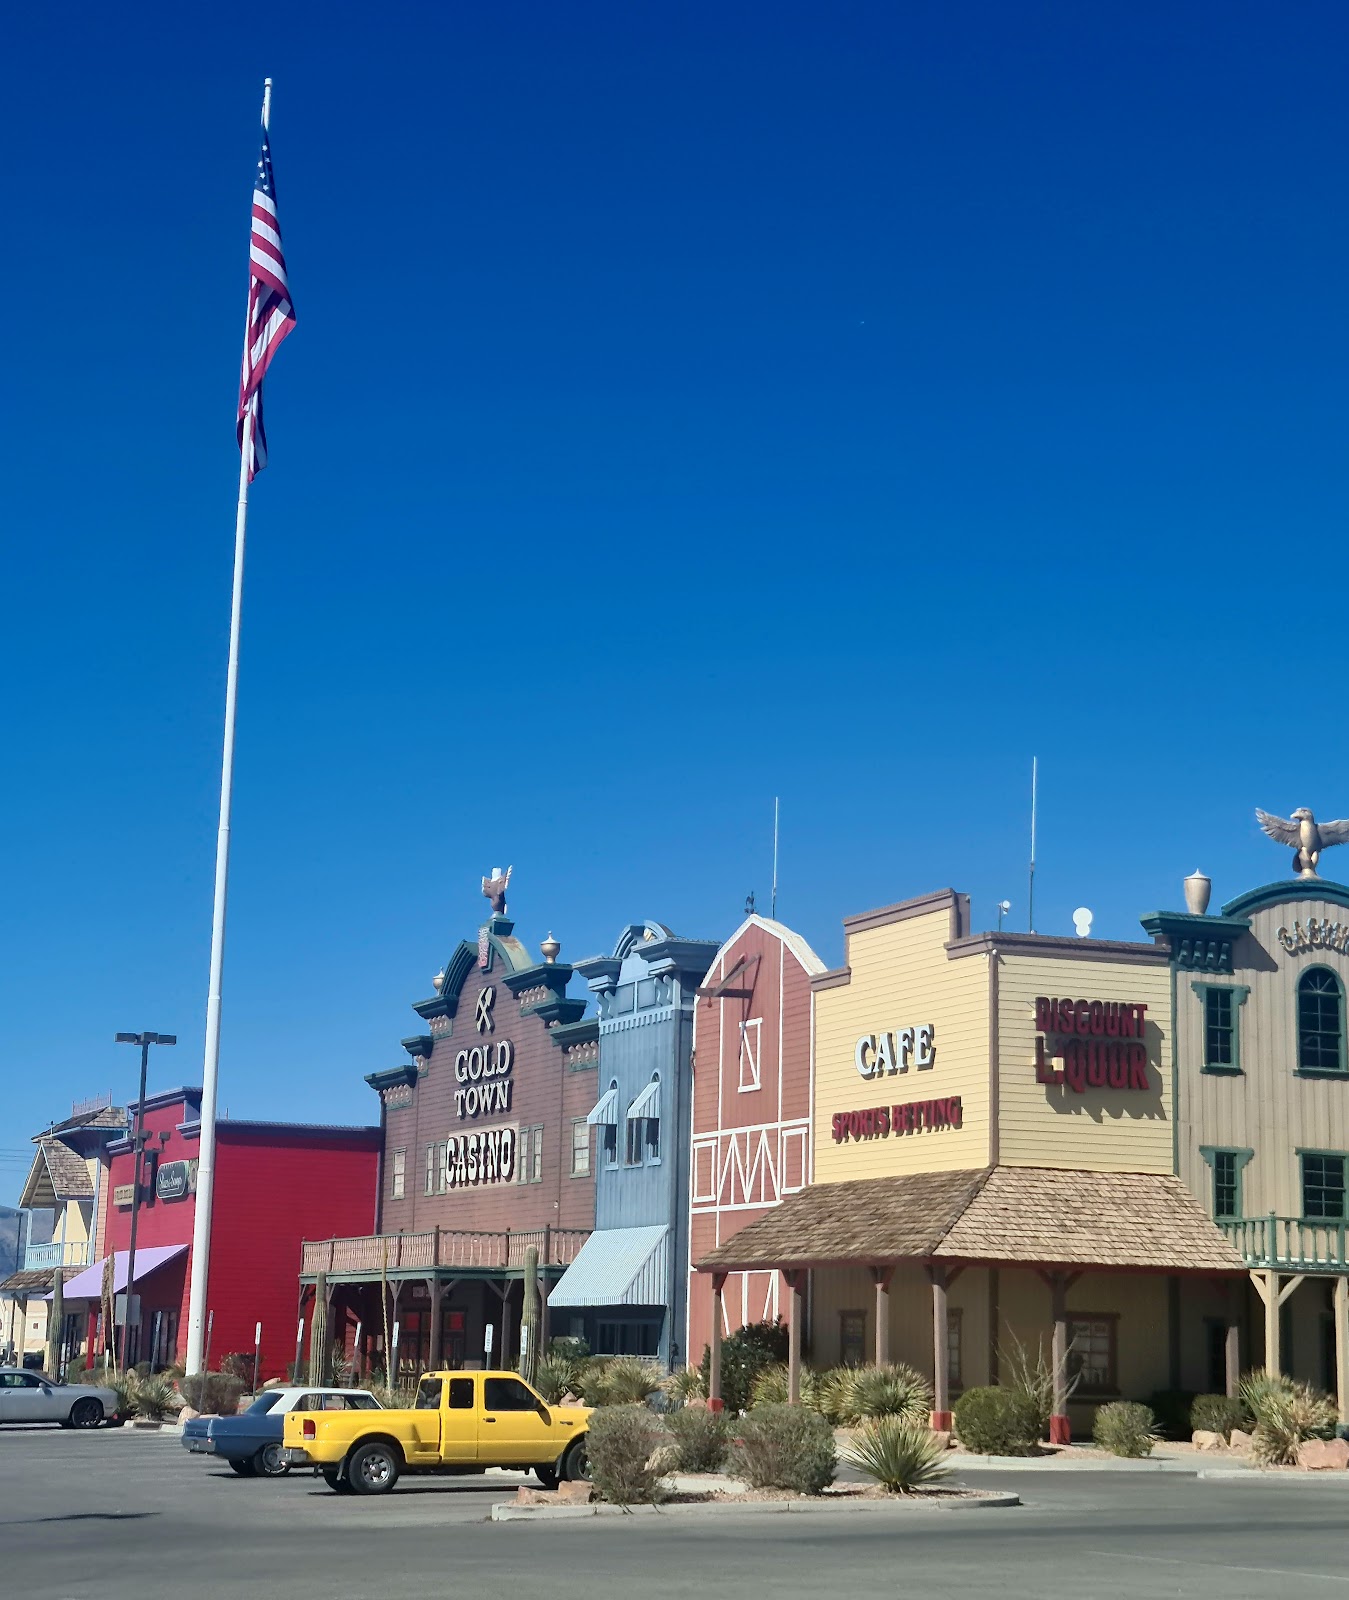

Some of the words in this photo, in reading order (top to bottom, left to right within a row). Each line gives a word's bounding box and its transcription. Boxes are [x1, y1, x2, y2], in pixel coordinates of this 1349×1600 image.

[1035, 996, 1148, 1038] DISCOUNT
[454, 1040, 513, 1083] GOLD
[854, 1023, 935, 1078] CAFE
[1035, 1035, 1149, 1093] LIQUOR
[454, 1079, 512, 1117] TOWN
[832, 1105, 889, 1142] SPORTS
[891, 1096, 962, 1135] BETTING
[446, 1129, 513, 1184] CASINO
